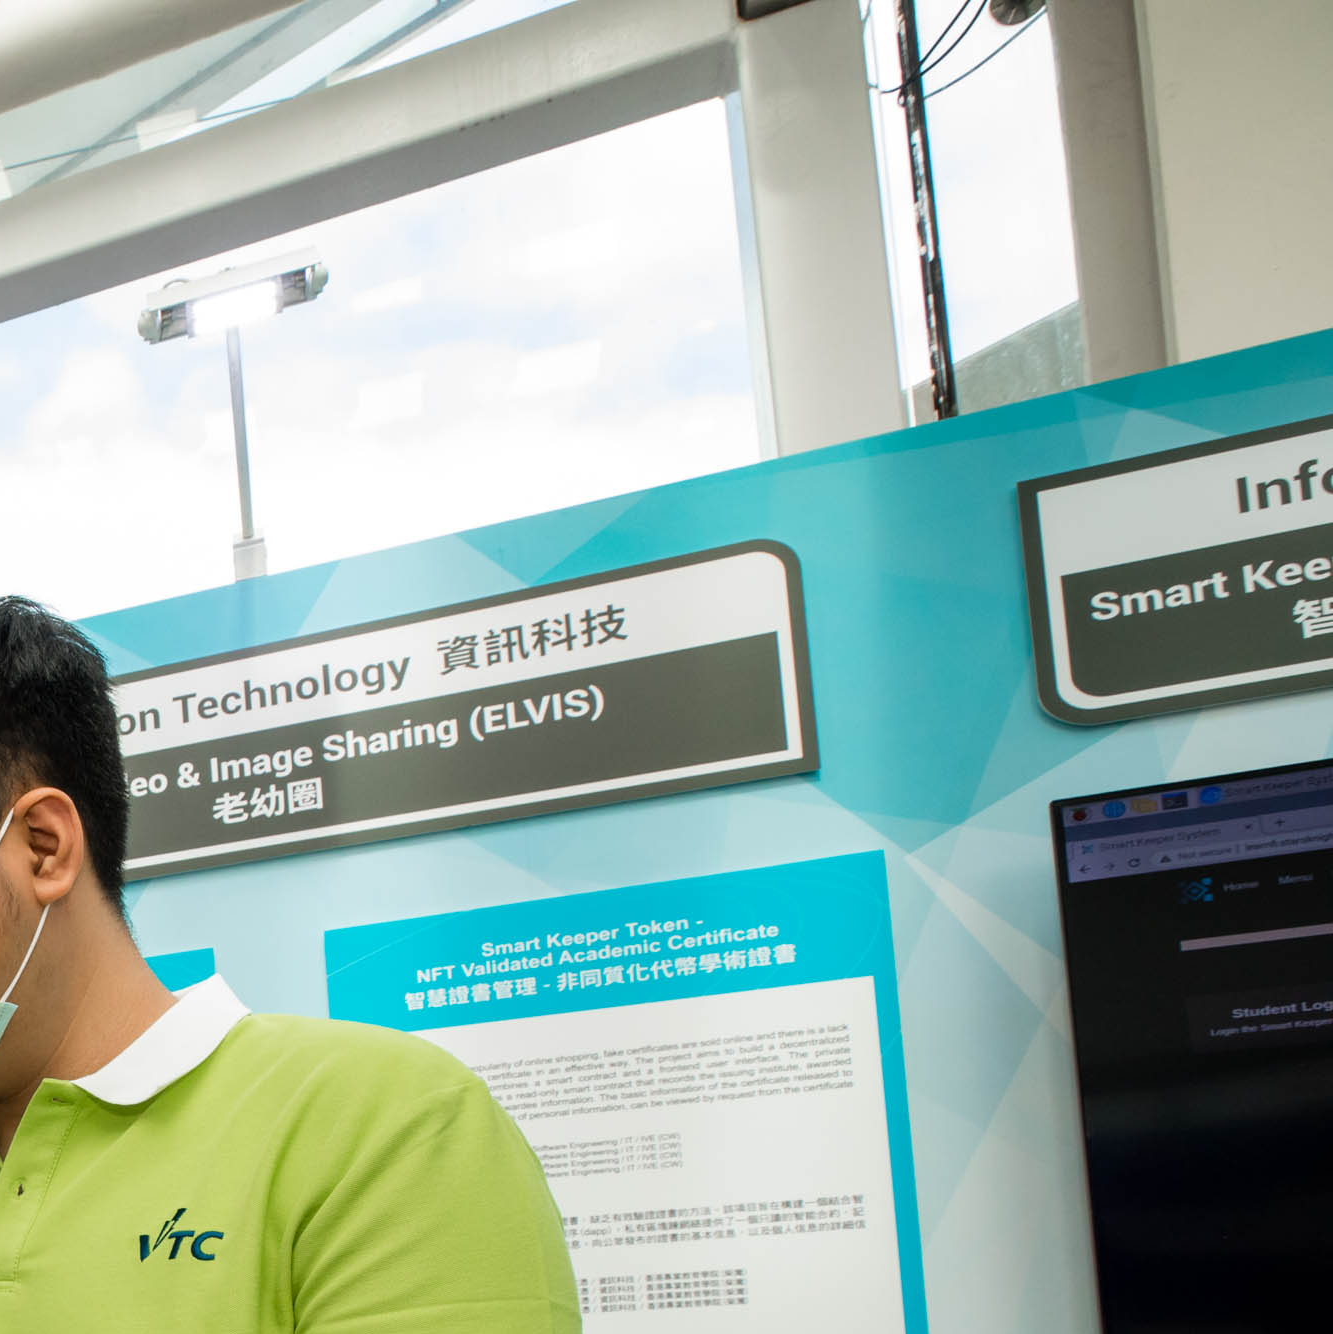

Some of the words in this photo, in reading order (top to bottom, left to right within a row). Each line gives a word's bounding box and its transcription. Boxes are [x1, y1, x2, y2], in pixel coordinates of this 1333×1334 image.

[1090, 570, 1230, 621] Smart
[172, 655, 411, 724] Technology
[437, 603, 629, 675] 資訊科技
[177, 761, 201, 788] &
[210, 745, 313, 783] Image
[322, 718, 459, 762] Sharing
[469, 685, 606, 743] (ELVIS)
[212, 777, 324, 825] 老幼圈
[416, 965, 456, 983] NFT
[461, 952, 553, 977] Validated
[559, 938, 661, 965] Academic
[668, 925, 779, 950] Certificate
[481, 936, 541, 957] Smart
[546, 928, 620, 949] Keeper
[625, 918, 689, 937] Token
[1232, 1002, 1297, 1018] Student
[139, 1208, 224, 1263] VTC
